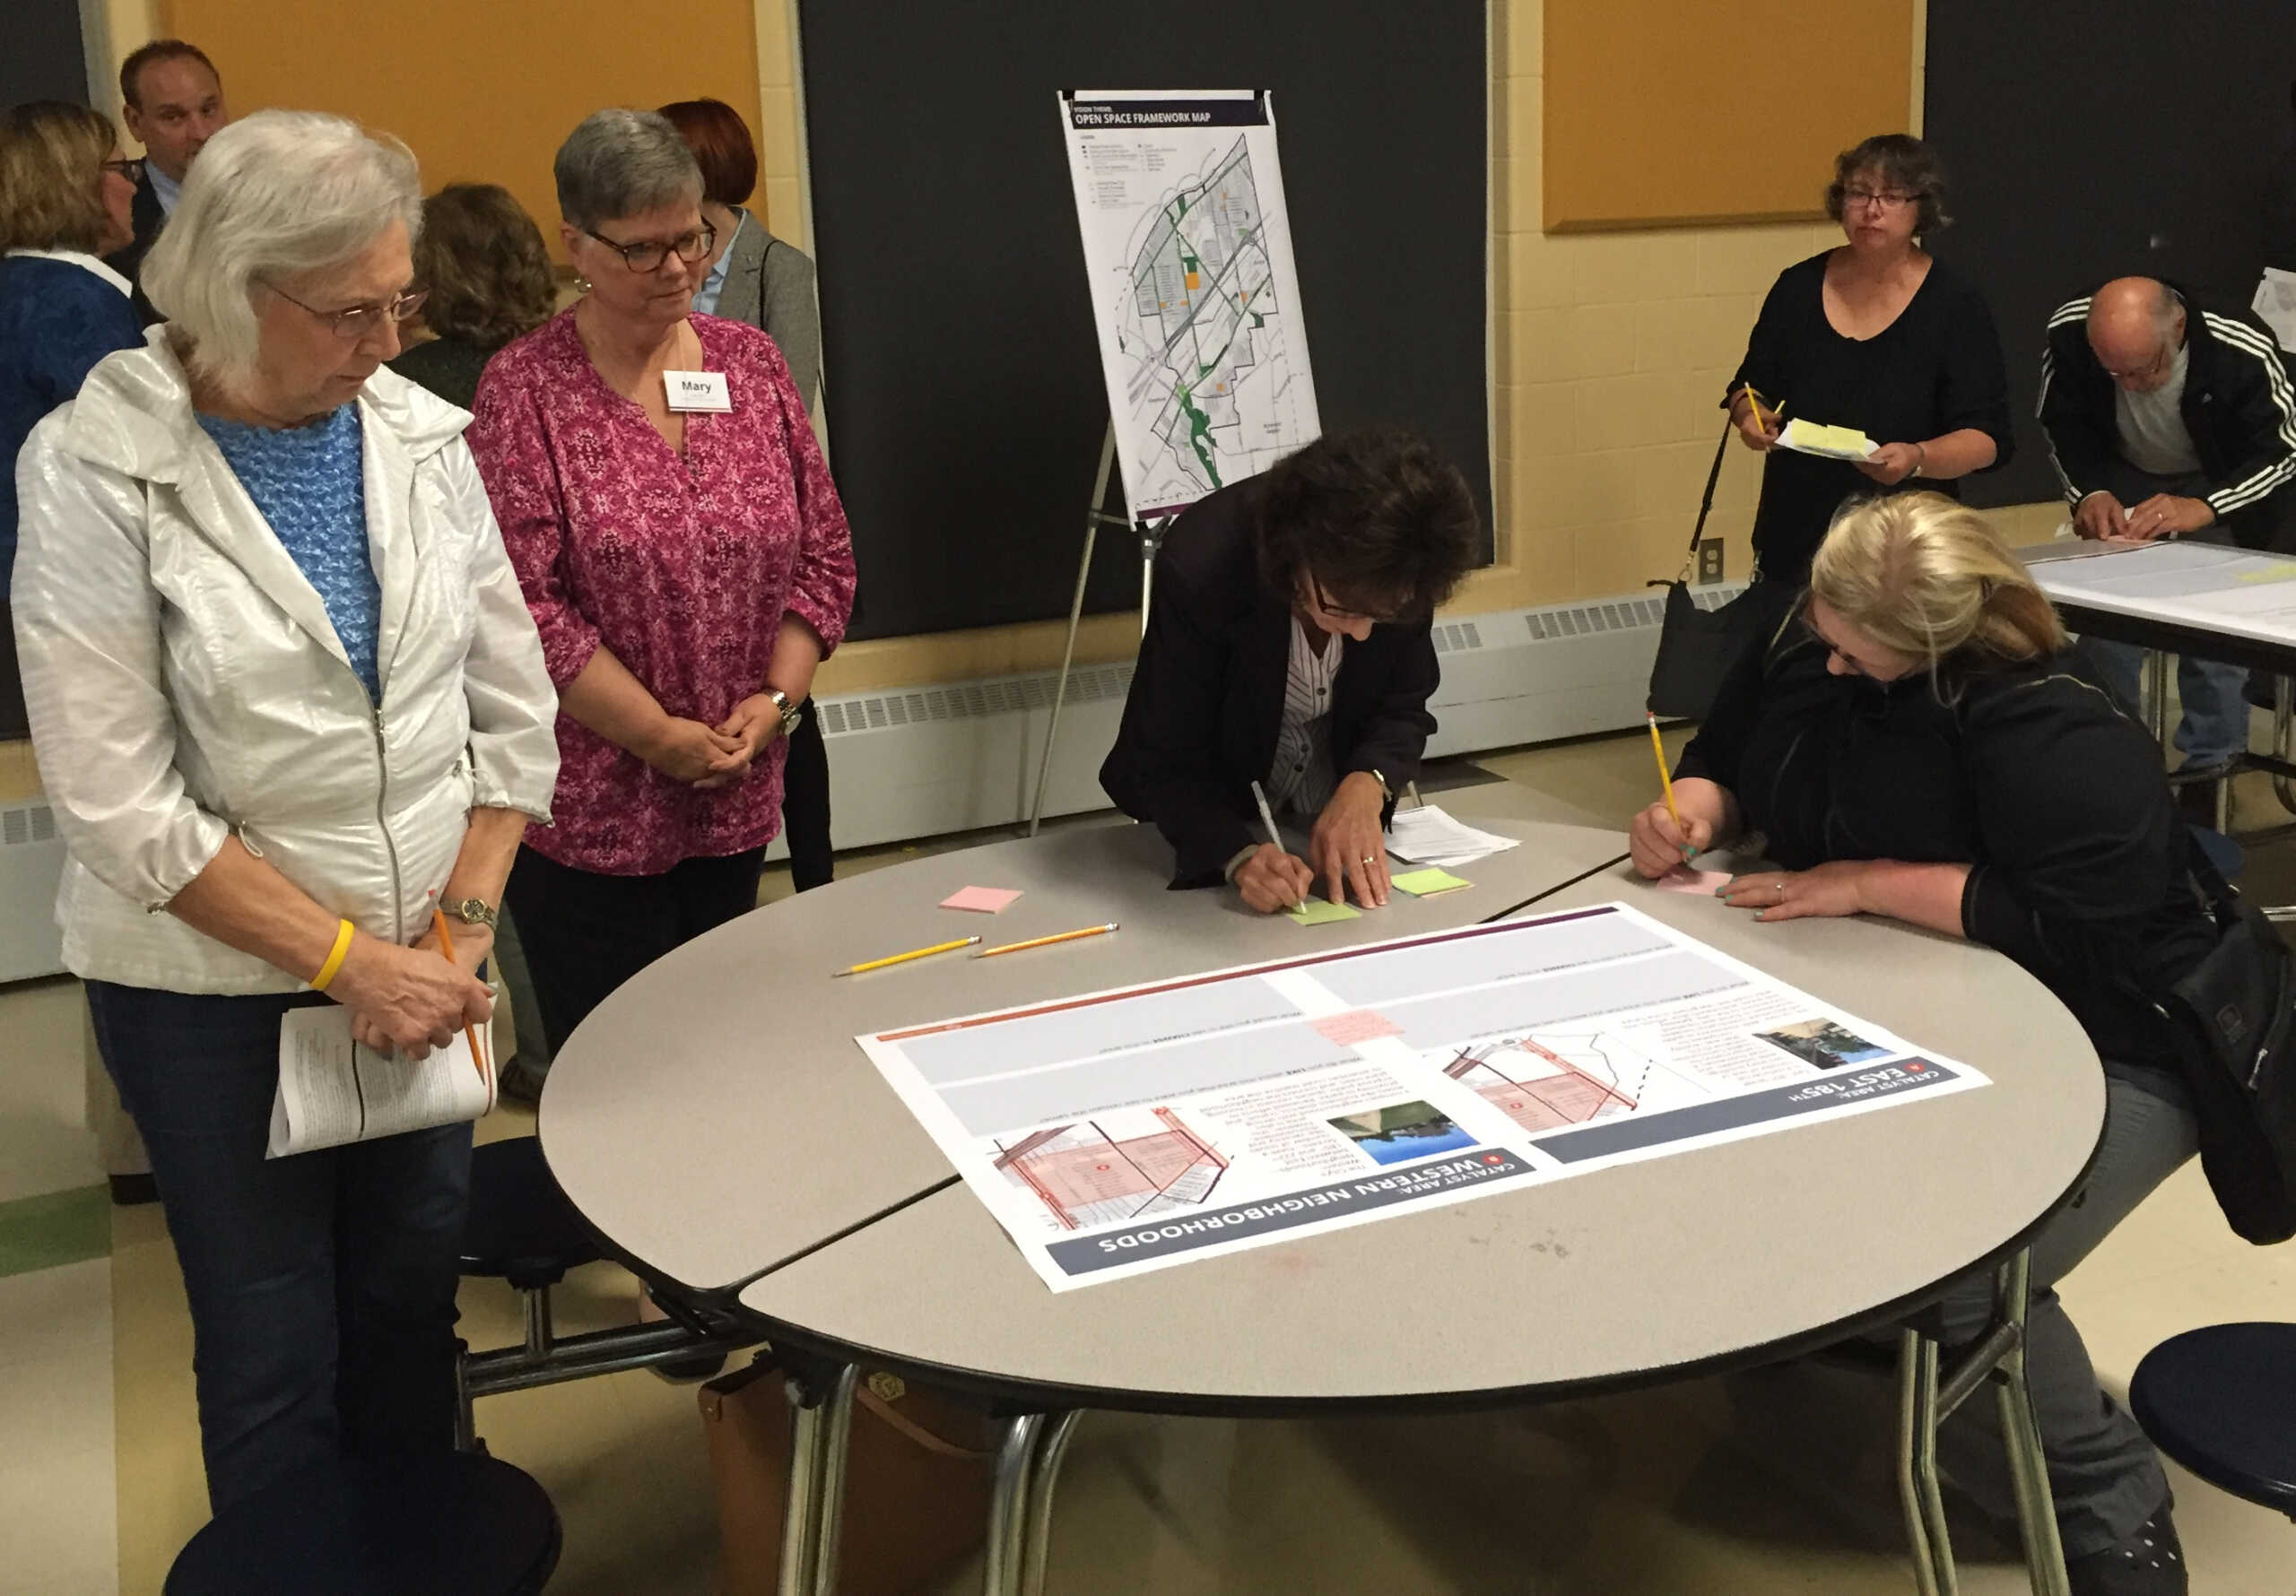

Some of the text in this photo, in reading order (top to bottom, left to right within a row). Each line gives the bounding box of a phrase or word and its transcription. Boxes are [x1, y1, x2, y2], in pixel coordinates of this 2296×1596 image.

[1075, 112, 1211, 125] OPEN SPACE FRAMEWORK MAP
[682, 381, 711, 394] Mary
[1847, 1067, 1907, 1088] EAST
[1876, 1070, 1940, 1092] CATALYST
[1354, 1158, 1484, 1196] WESTERN
[1445, 1162, 1516, 1186] CATALYST
[1098, 1187, 1352, 1253] NEIGHBORHOODS
